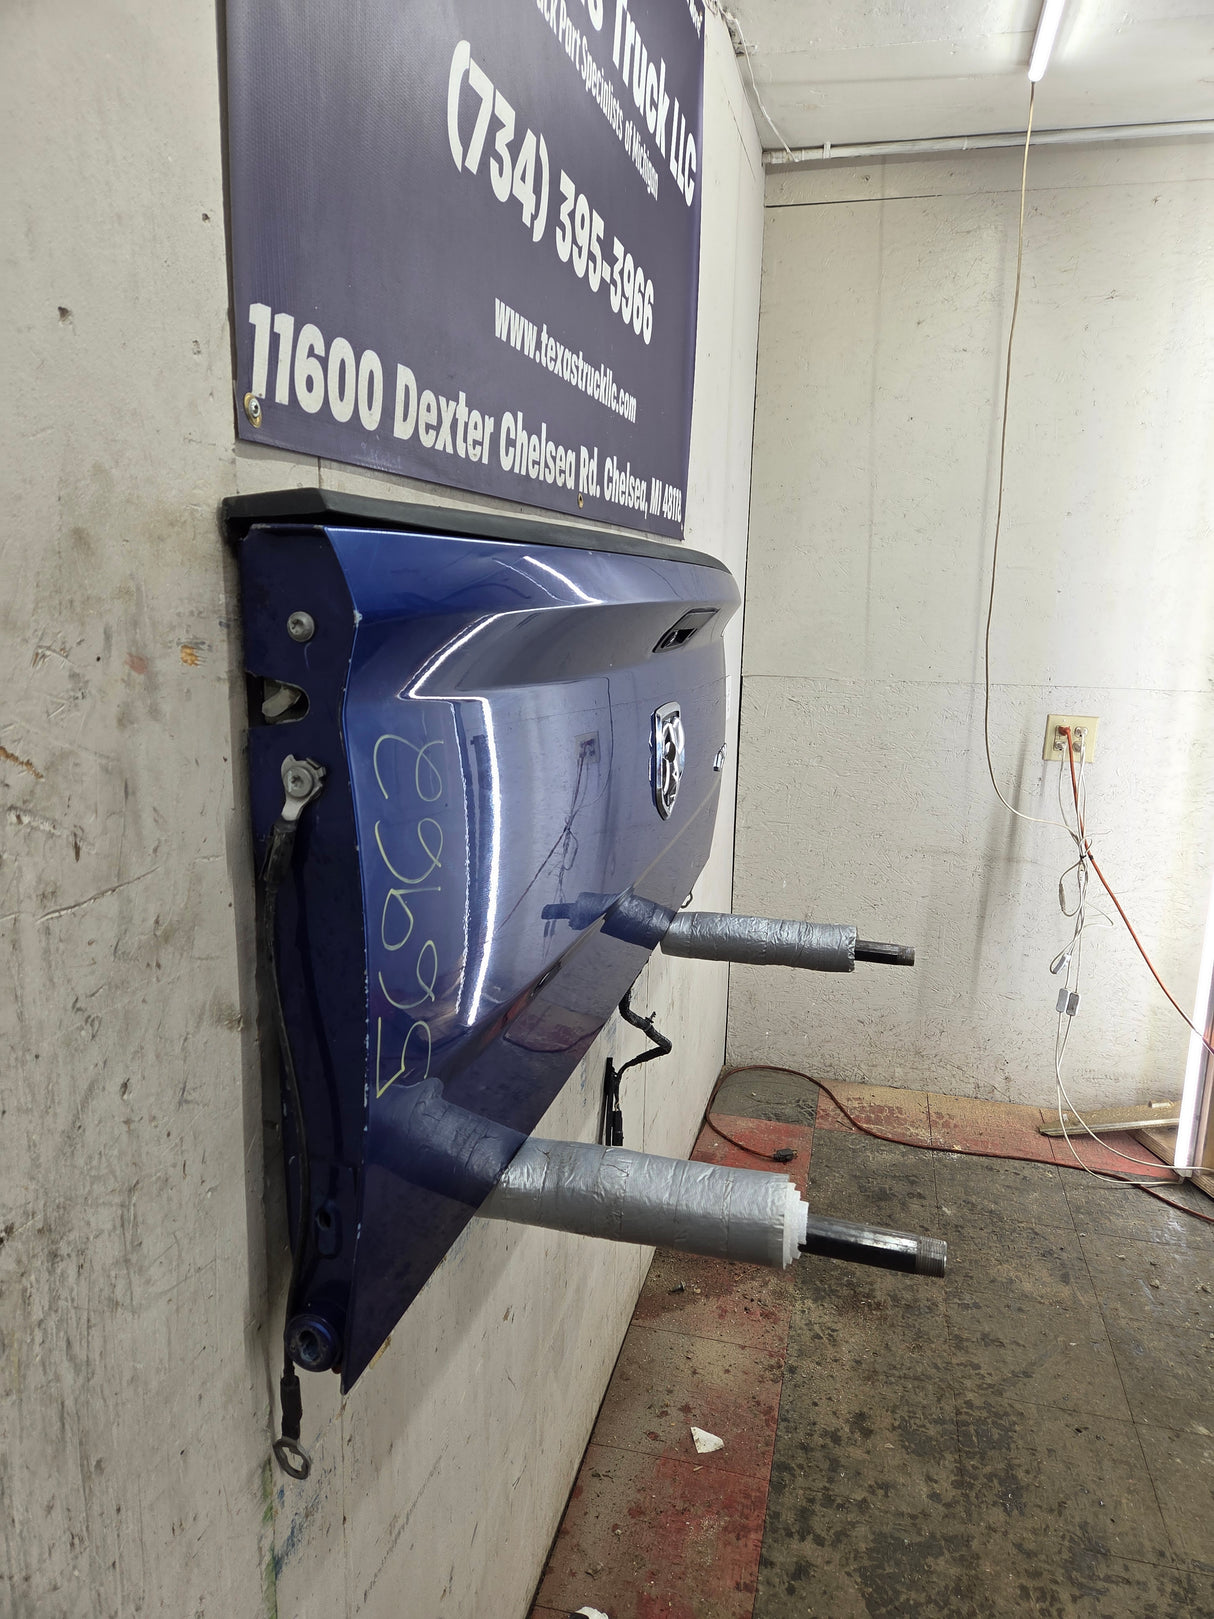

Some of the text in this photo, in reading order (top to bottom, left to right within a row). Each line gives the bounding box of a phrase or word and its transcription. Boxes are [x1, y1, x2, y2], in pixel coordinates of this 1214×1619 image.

[557, 0, 582, 72] Part
[581, 35, 624, 142] Specialists
[624, 120, 633, 156] of
[612, 0, 697, 207] Truck LLC
[447, 39, 655, 345] (734) 395-3966
[249, 302, 384, 431] 11600
[393, 363, 495, 465] Dexter
[499, 411, 576, 492] Chelsea
[578, 445, 600, 497] Rd.
[603, 455, 648, 520] Chelsea,
[649, 477, 663, 516] MI
[494, 297, 637, 423] www.texastruckllc.com
[373, 733, 445, 1099] 56962
